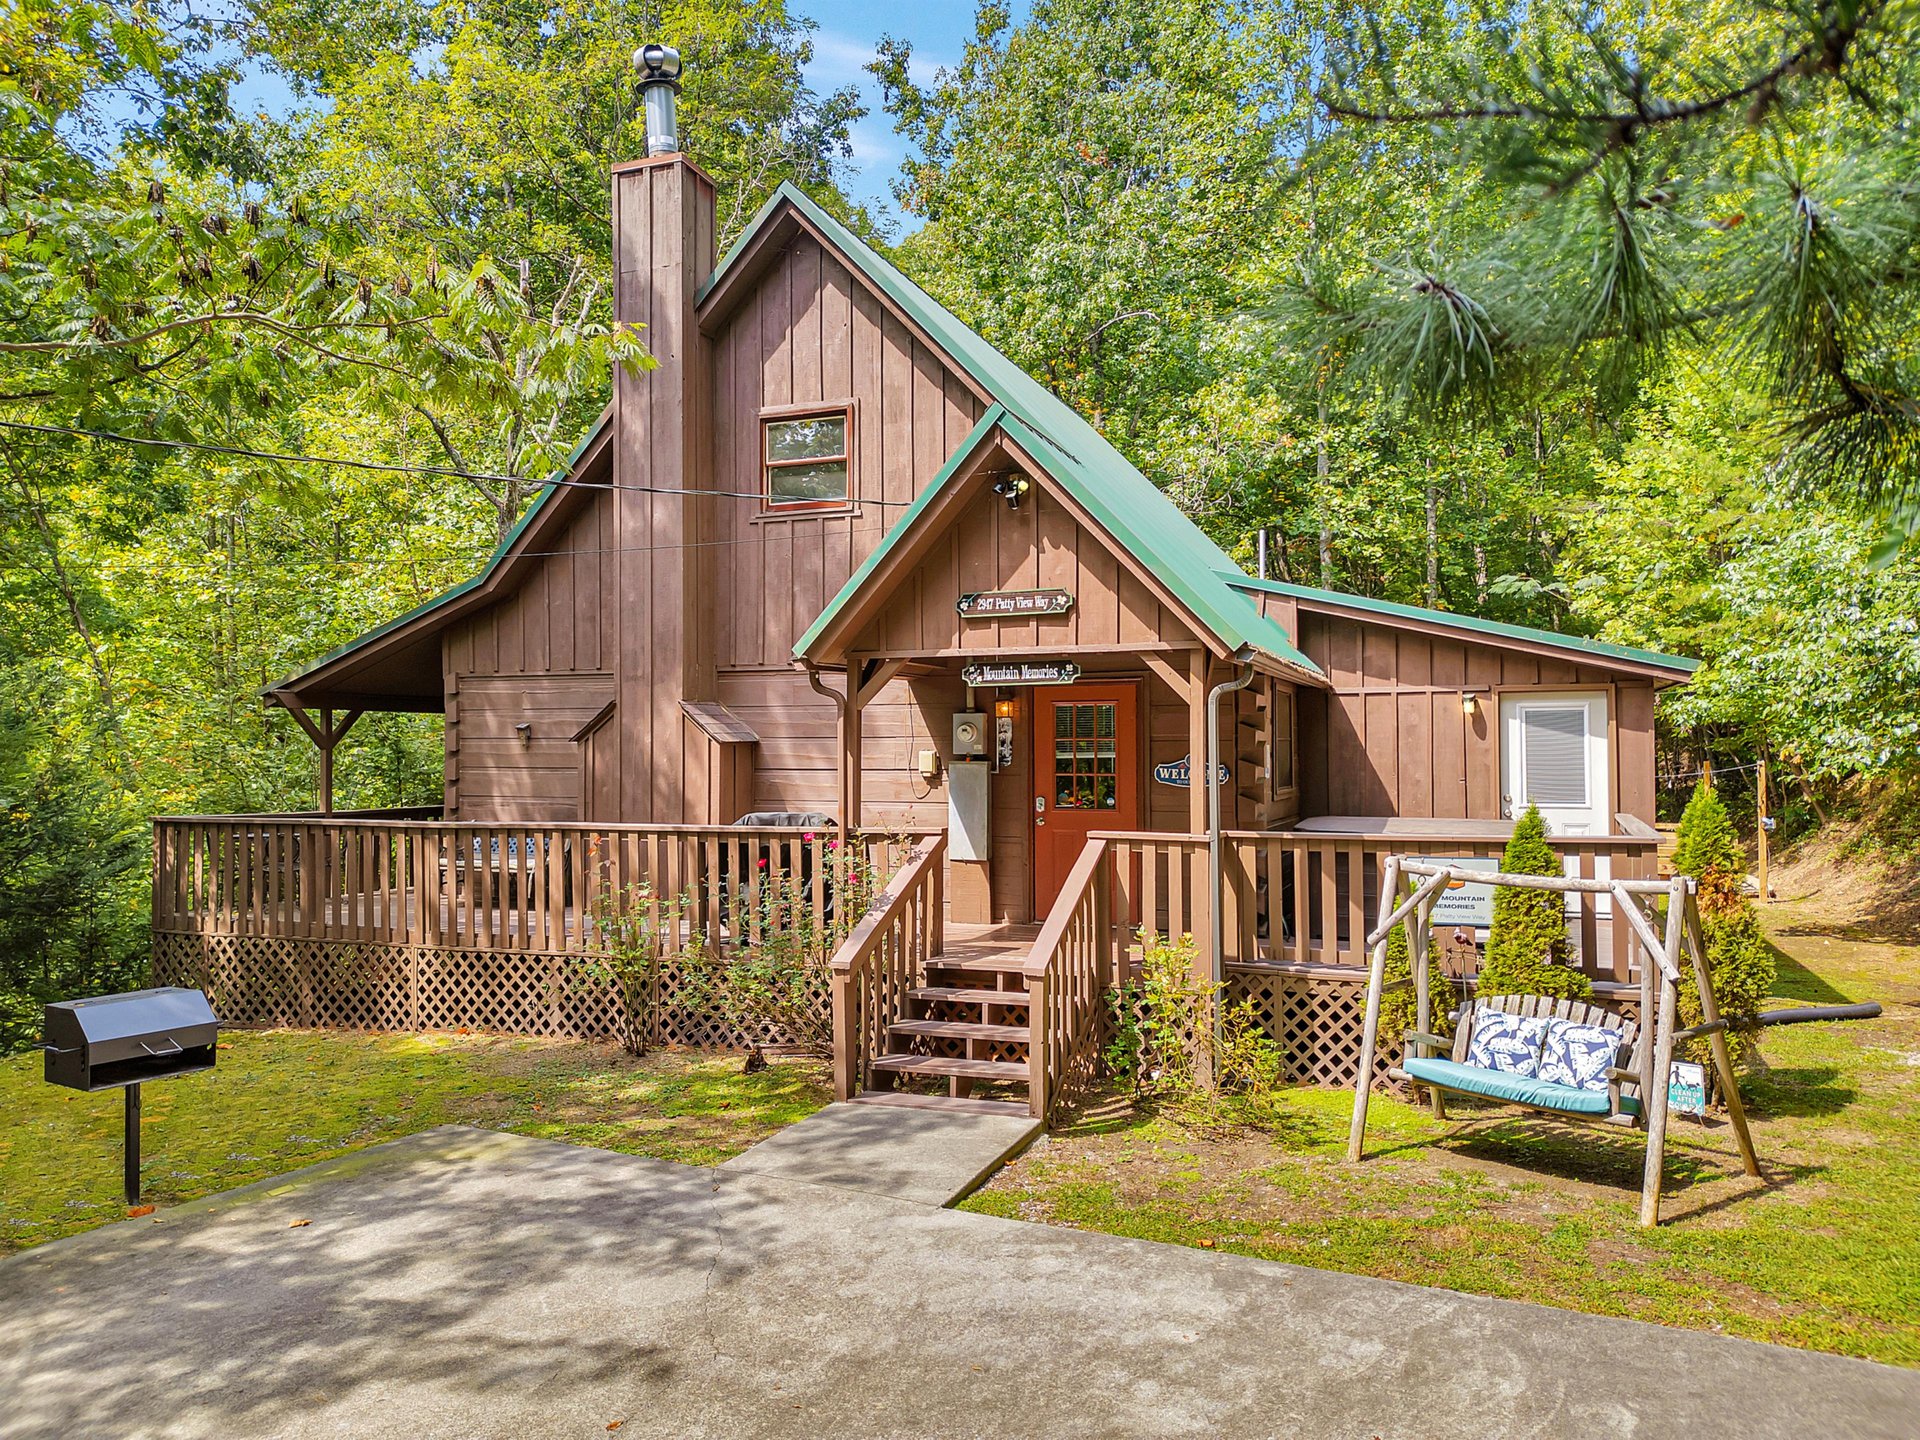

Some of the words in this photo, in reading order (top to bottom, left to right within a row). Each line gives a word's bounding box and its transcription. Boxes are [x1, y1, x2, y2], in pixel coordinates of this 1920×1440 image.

[995, 597, 1015, 612] Patty
[1015, 596, 1033, 608] View
[1034, 595, 1049, 610] Way
[983, 665, 1019, 681] Mountain
[1021, 664, 1058, 680] Memories
[1159, 768, 1225, 780] WELE
[1671, 1089, 1691, 1098] CLEAN
[1677, 1096, 1697, 1104] AFTER
